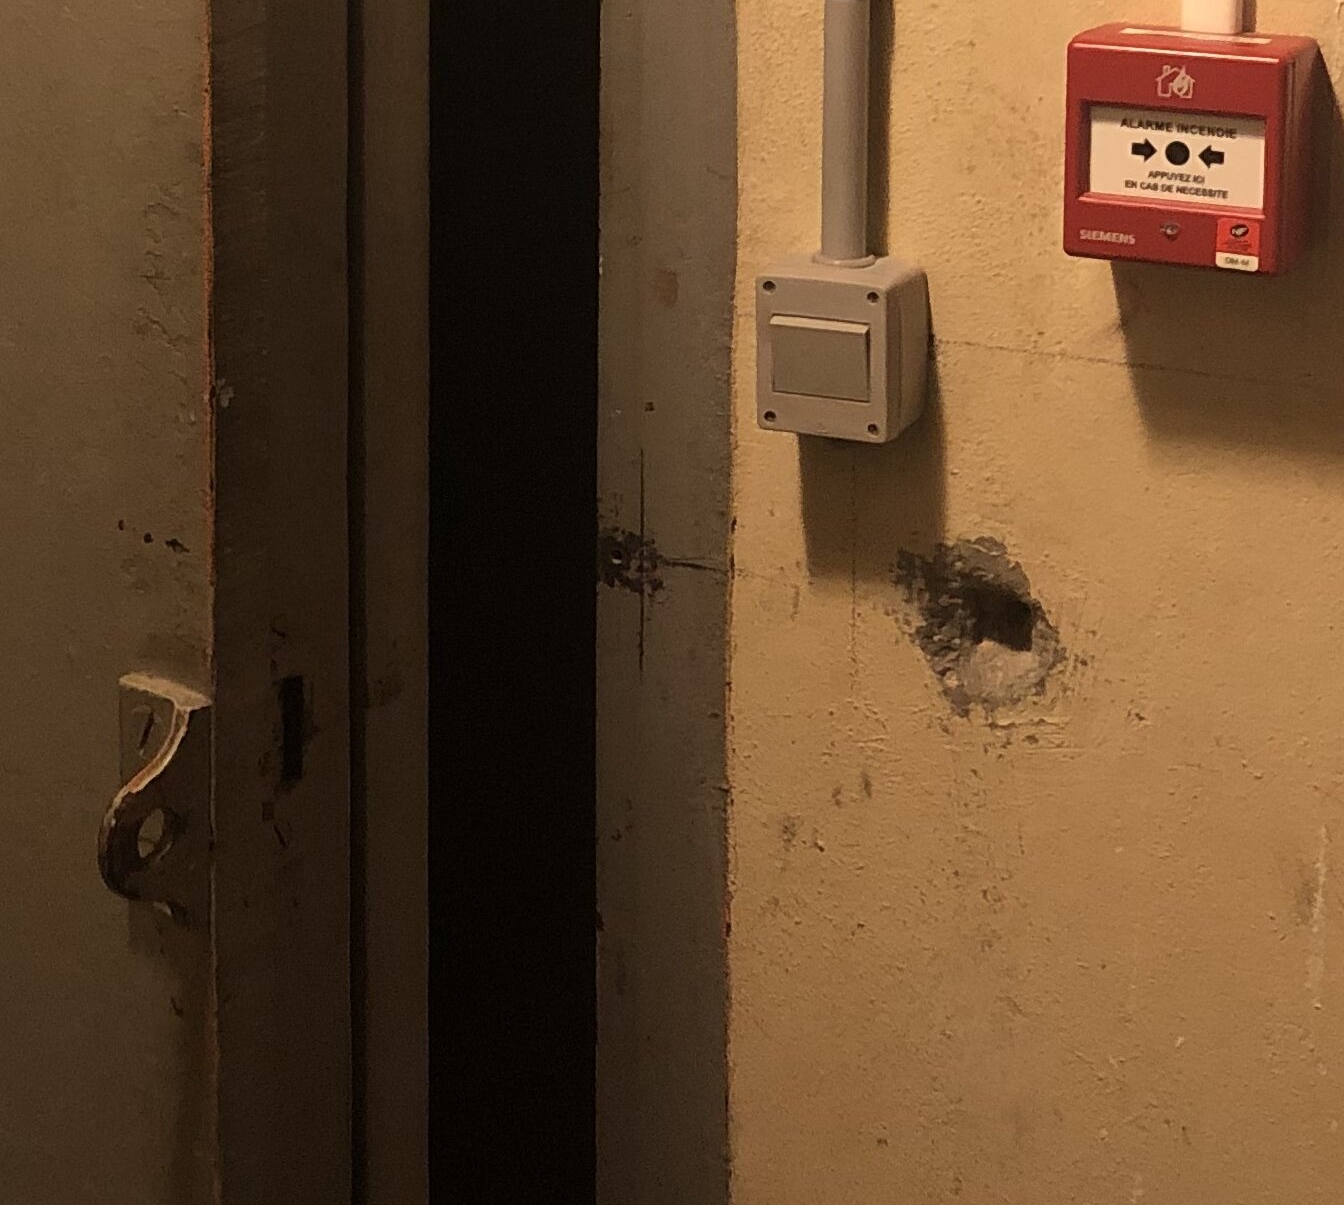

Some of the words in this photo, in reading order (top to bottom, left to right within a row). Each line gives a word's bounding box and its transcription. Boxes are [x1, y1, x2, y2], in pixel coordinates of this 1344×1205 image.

[1119, 117, 1174, 134] ALARME
[1175, 125, 1238, 140] INCENDIE
[1147, 170, 1193, 184] APPUYEZ
[1124, 179, 1138, 190] EN
[1139, 181, 1159, 192] CAS
[1160, 183, 1174, 194] DE
[1079, 228, 1137, 245] SIEMENS
